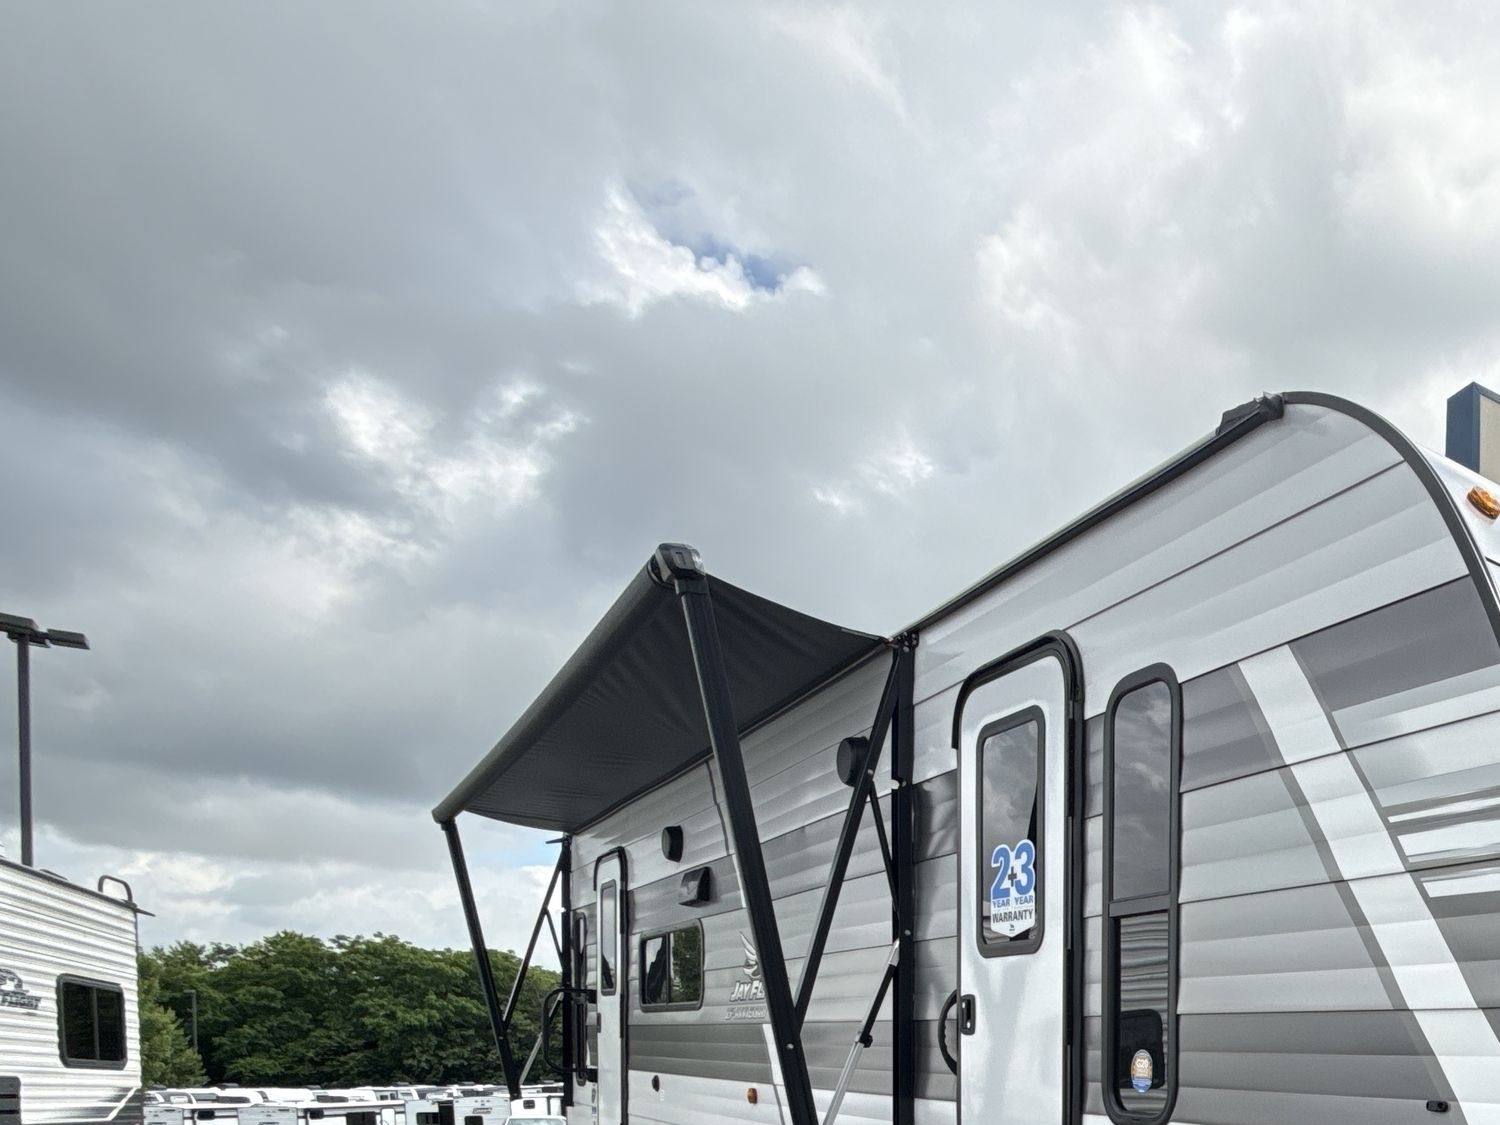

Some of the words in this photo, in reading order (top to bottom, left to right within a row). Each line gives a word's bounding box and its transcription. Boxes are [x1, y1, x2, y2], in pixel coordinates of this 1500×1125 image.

[992, 899, 1010, 908] YEAR
[1014, 895, 1033, 905] YEAR
[992, 909, 1033, 924] WARRANTY
